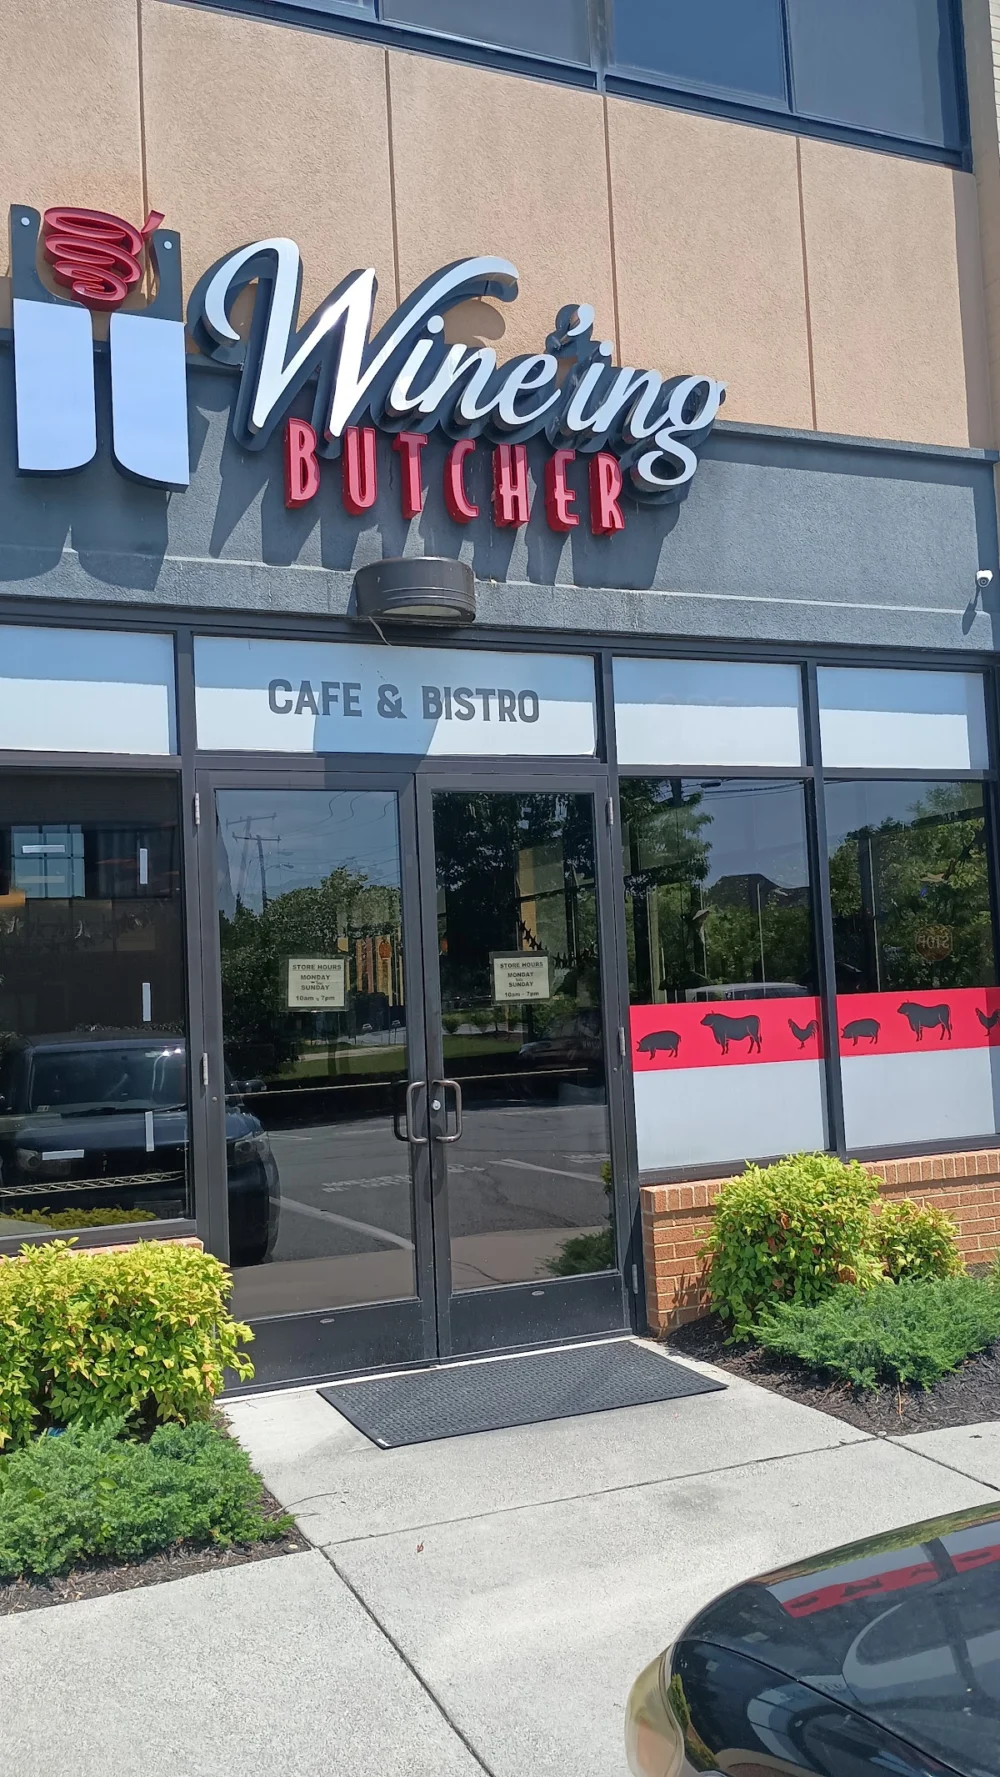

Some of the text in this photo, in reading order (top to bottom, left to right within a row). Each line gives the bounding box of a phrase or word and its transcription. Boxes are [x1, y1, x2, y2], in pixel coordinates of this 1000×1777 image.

[203, 237, 729, 488] Wine'ing
[283, 418, 625, 535] BUTCHER
[268, 679, 540, 723] CAFE & BISTRO
